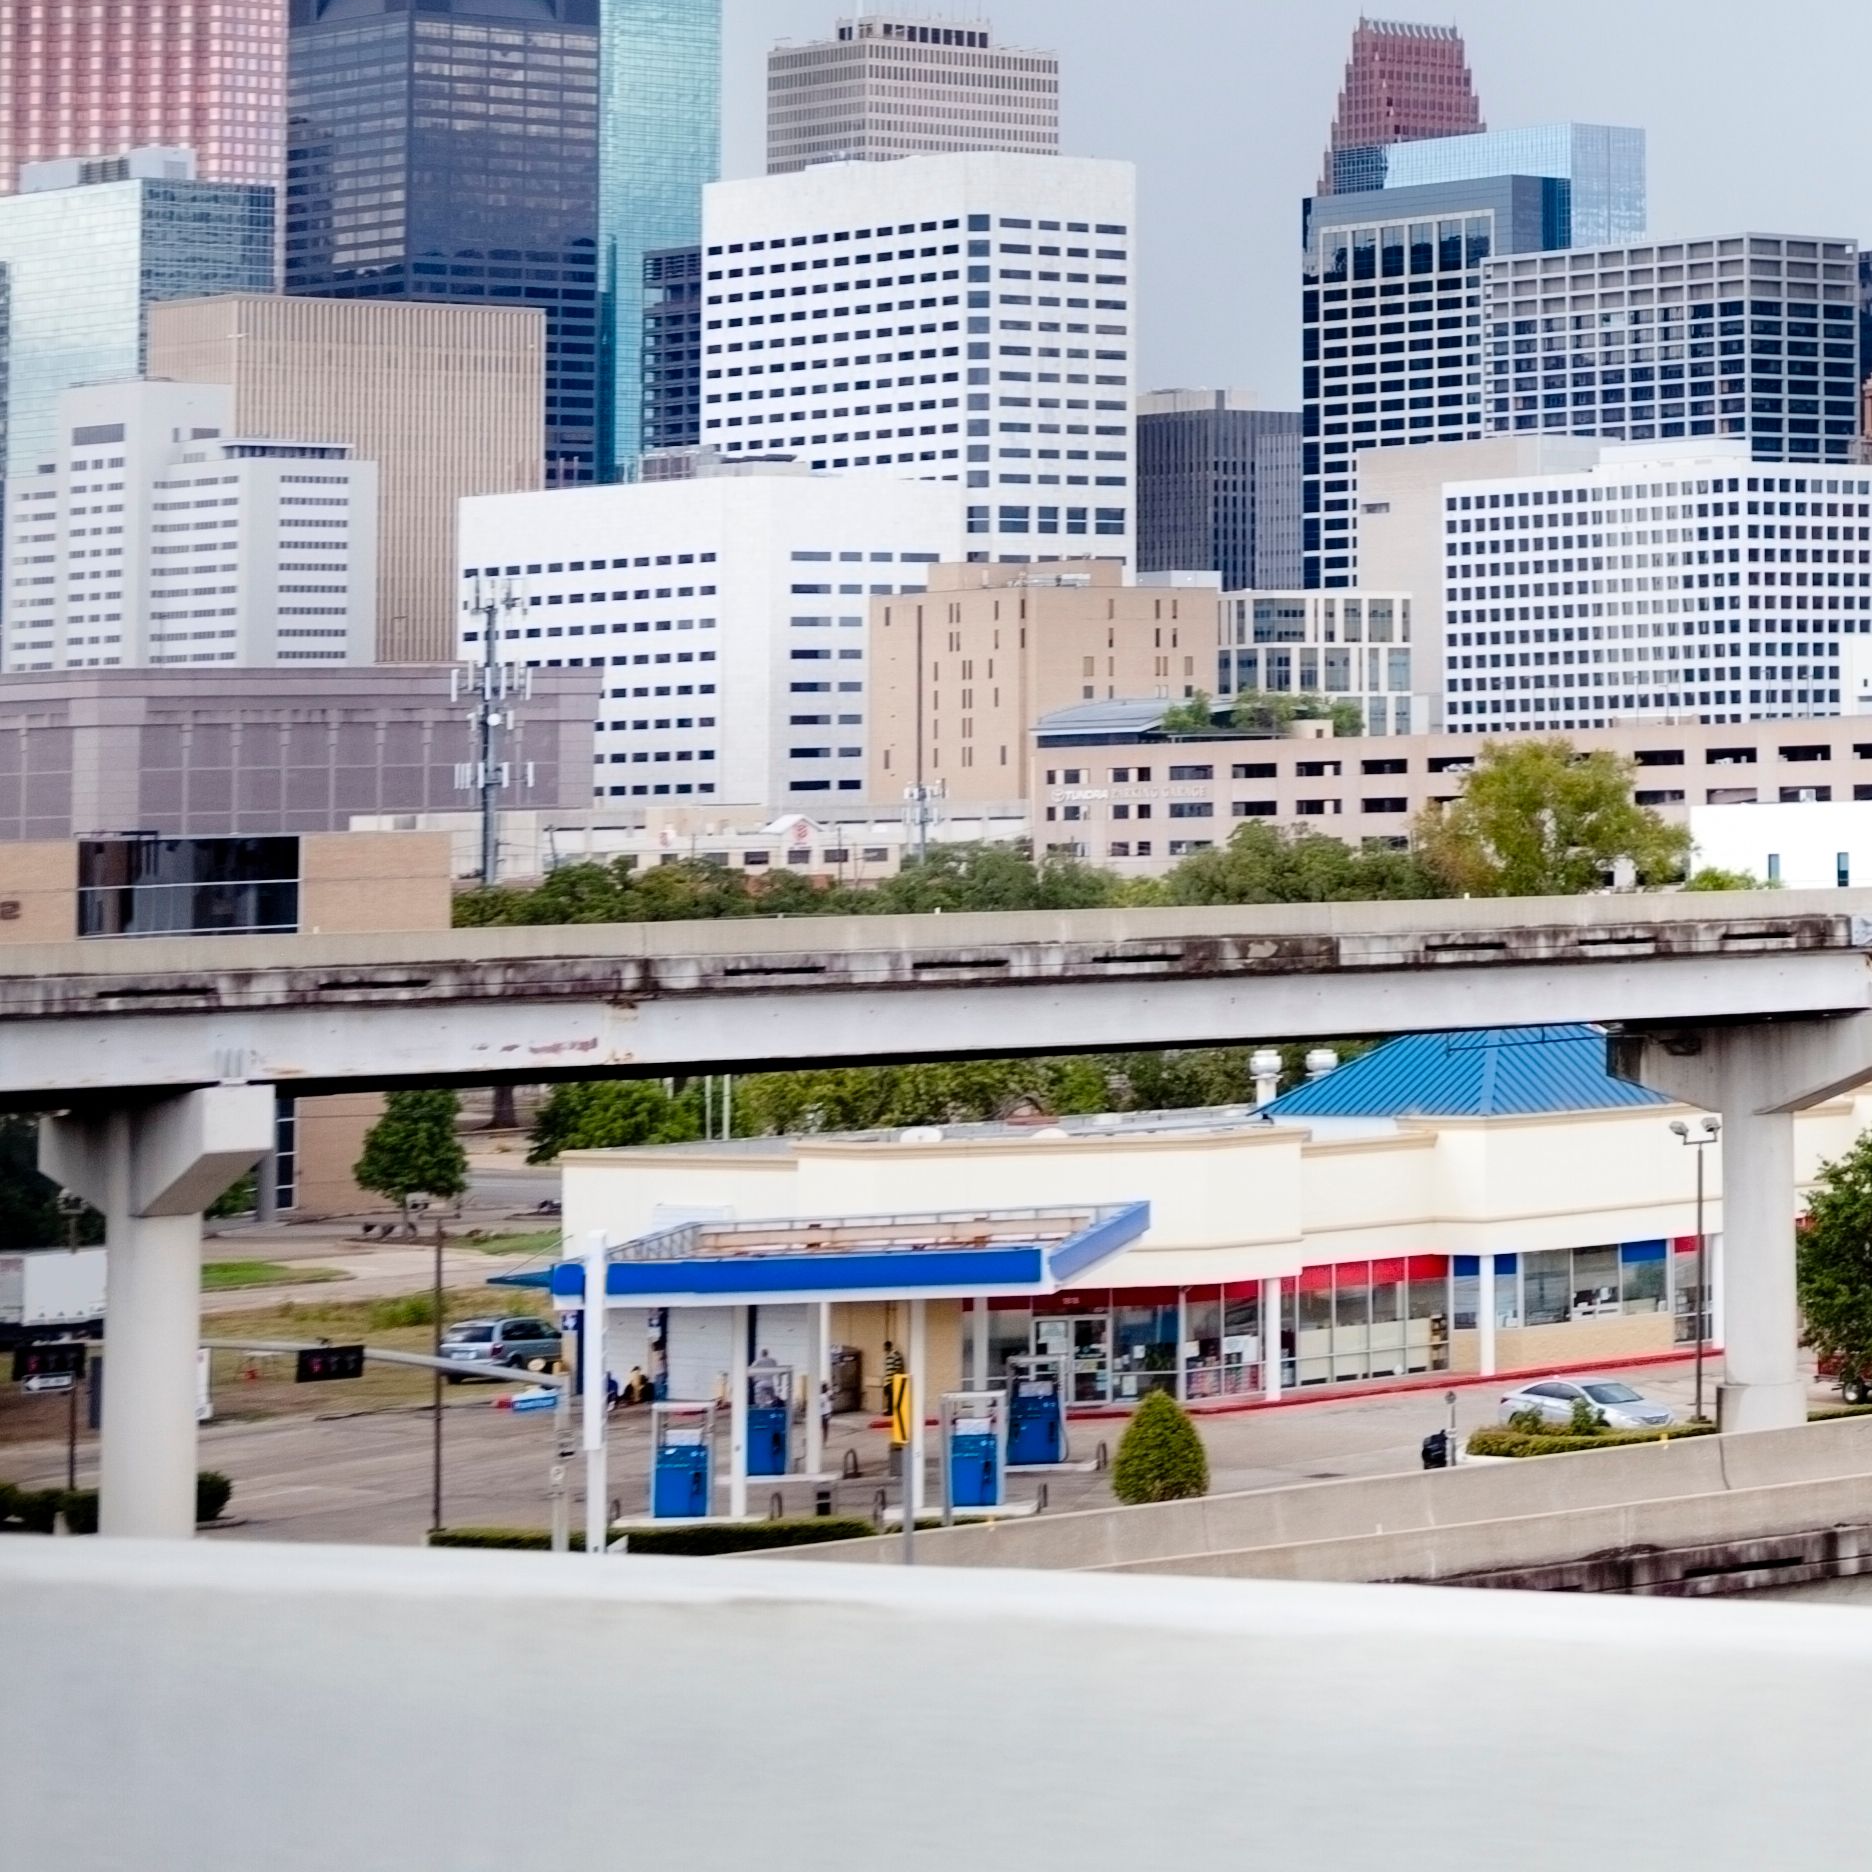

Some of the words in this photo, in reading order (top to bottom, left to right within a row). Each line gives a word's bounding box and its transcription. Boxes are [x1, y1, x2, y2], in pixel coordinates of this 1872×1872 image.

[1065, 788, 1109, 801] TUNDRA
[1111, 787, 1159, 800] PARKING
[1161, 785, 1208, 799] GARAGE
